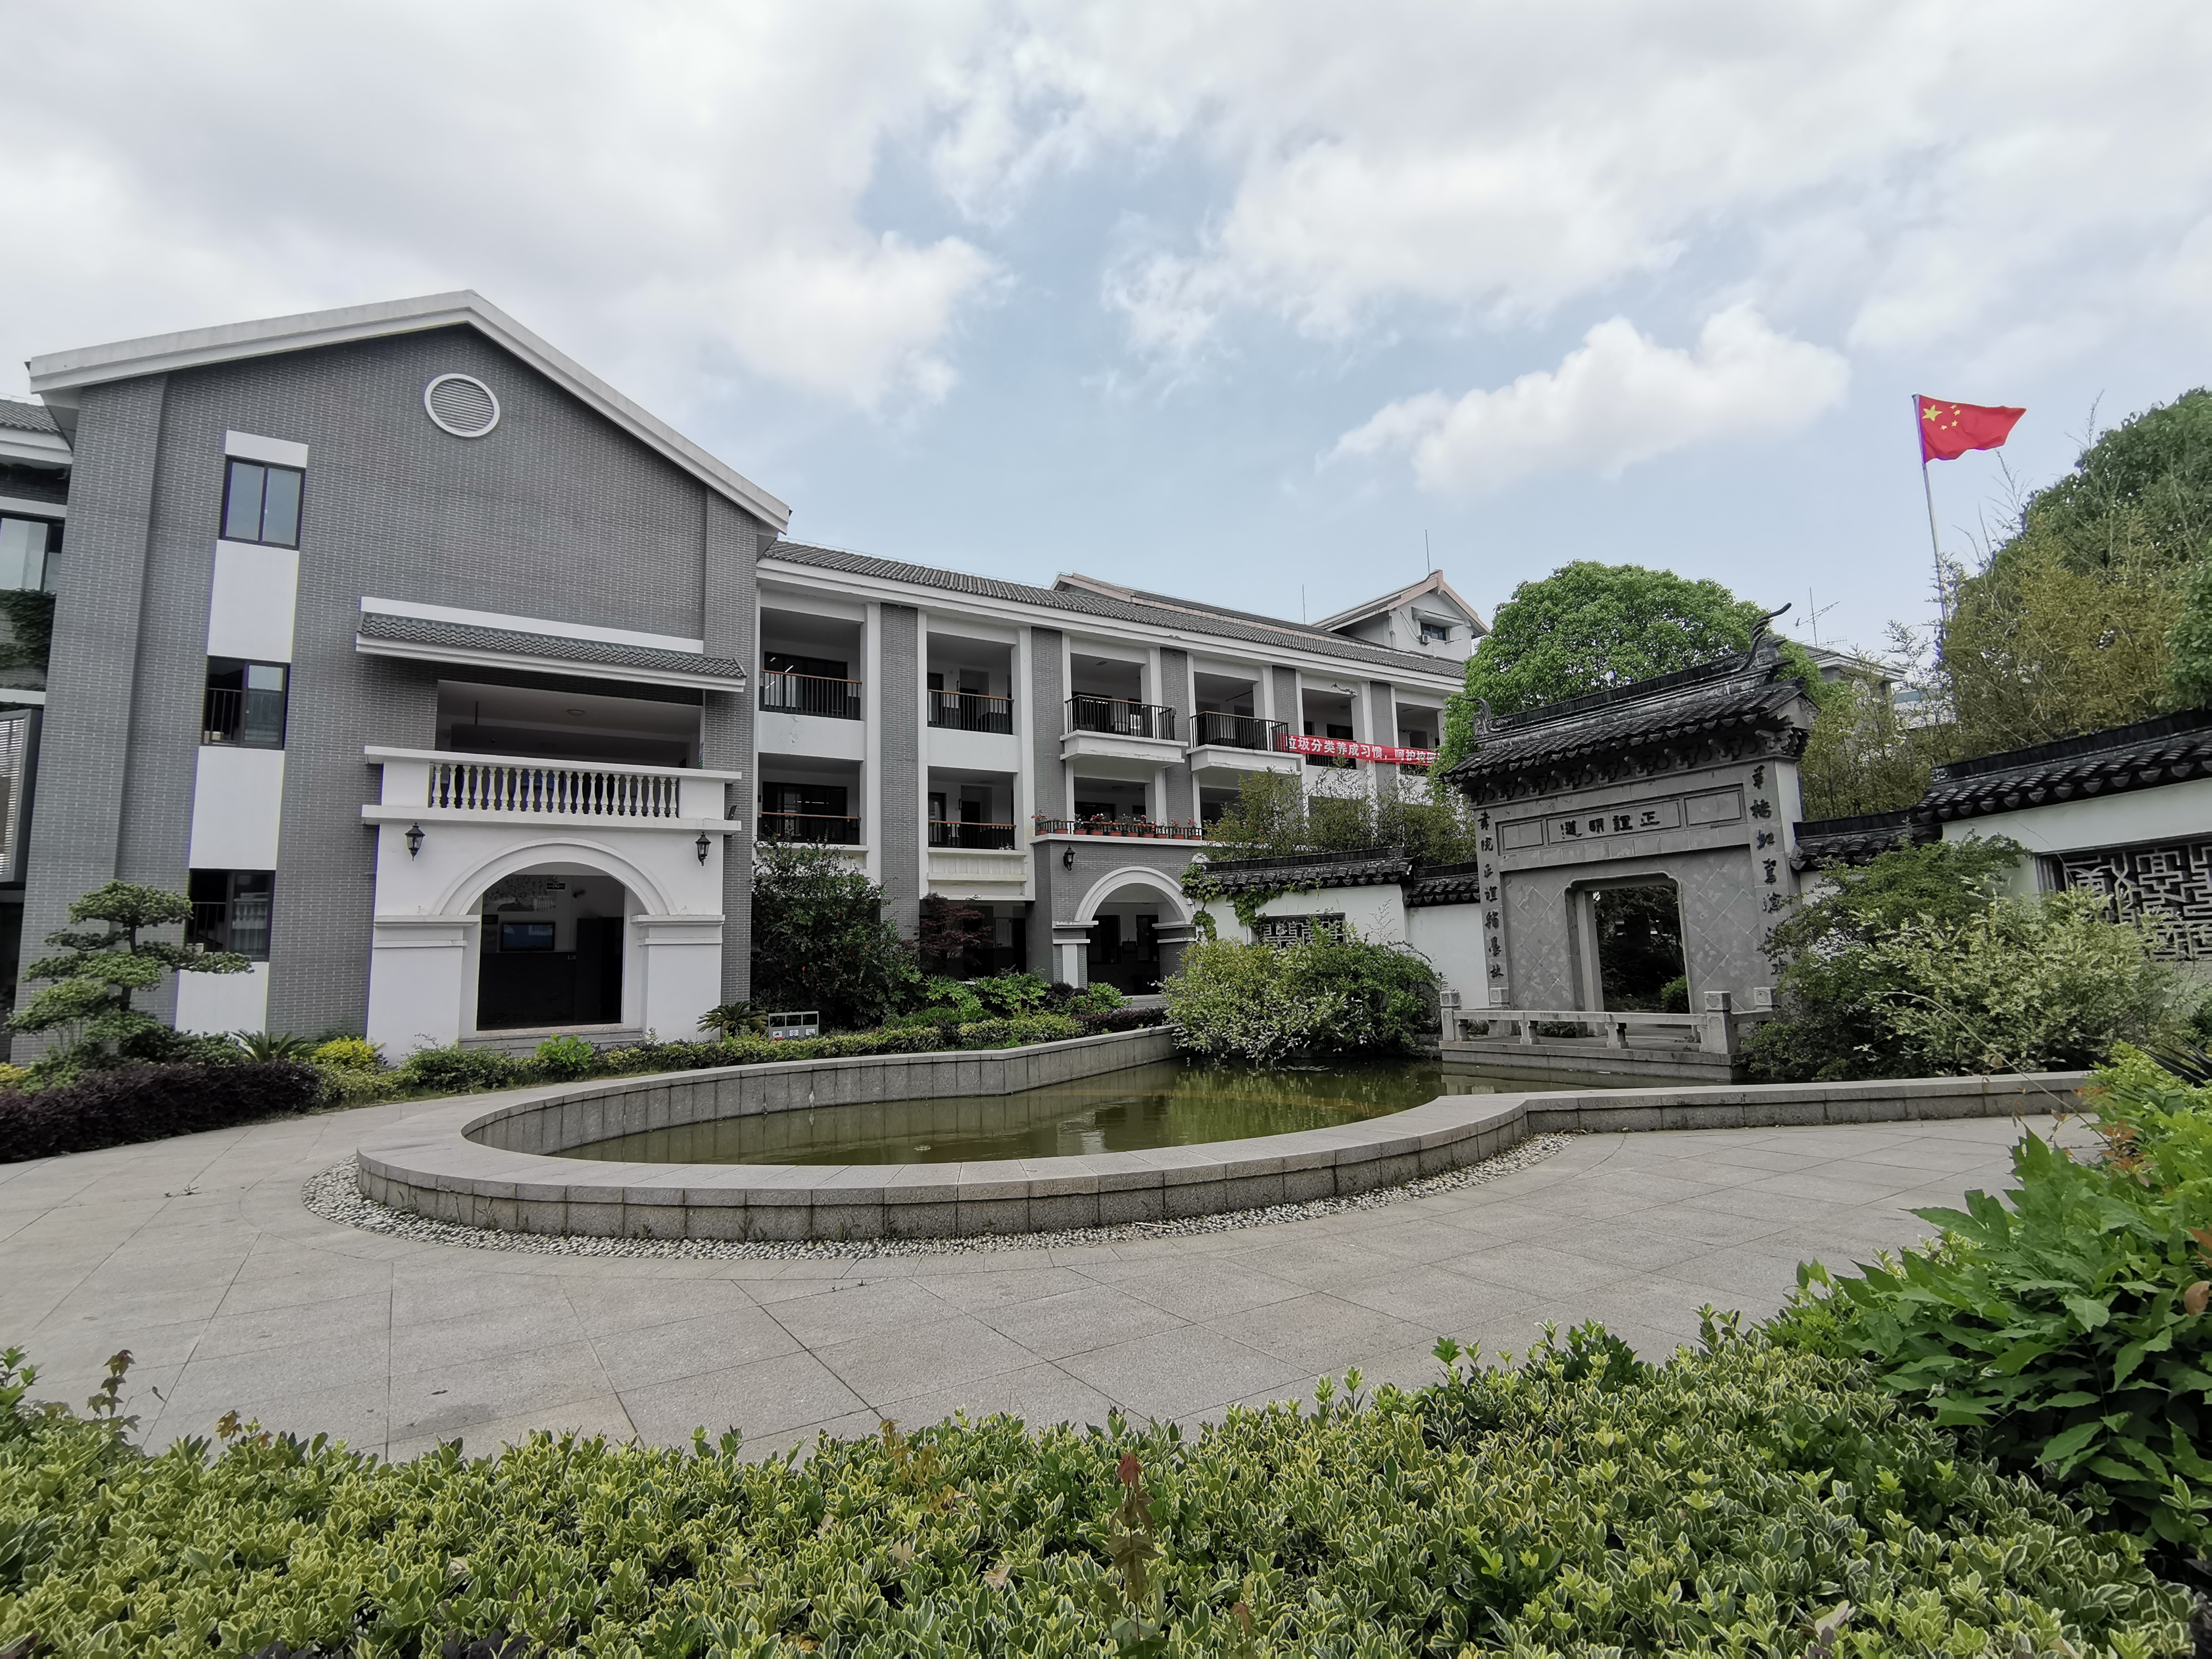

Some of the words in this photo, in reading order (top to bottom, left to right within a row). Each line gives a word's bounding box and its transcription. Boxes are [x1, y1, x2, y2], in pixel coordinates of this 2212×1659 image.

[1285, 735, 1441, 763] 垃圾分类养成习惯，呵护校园
